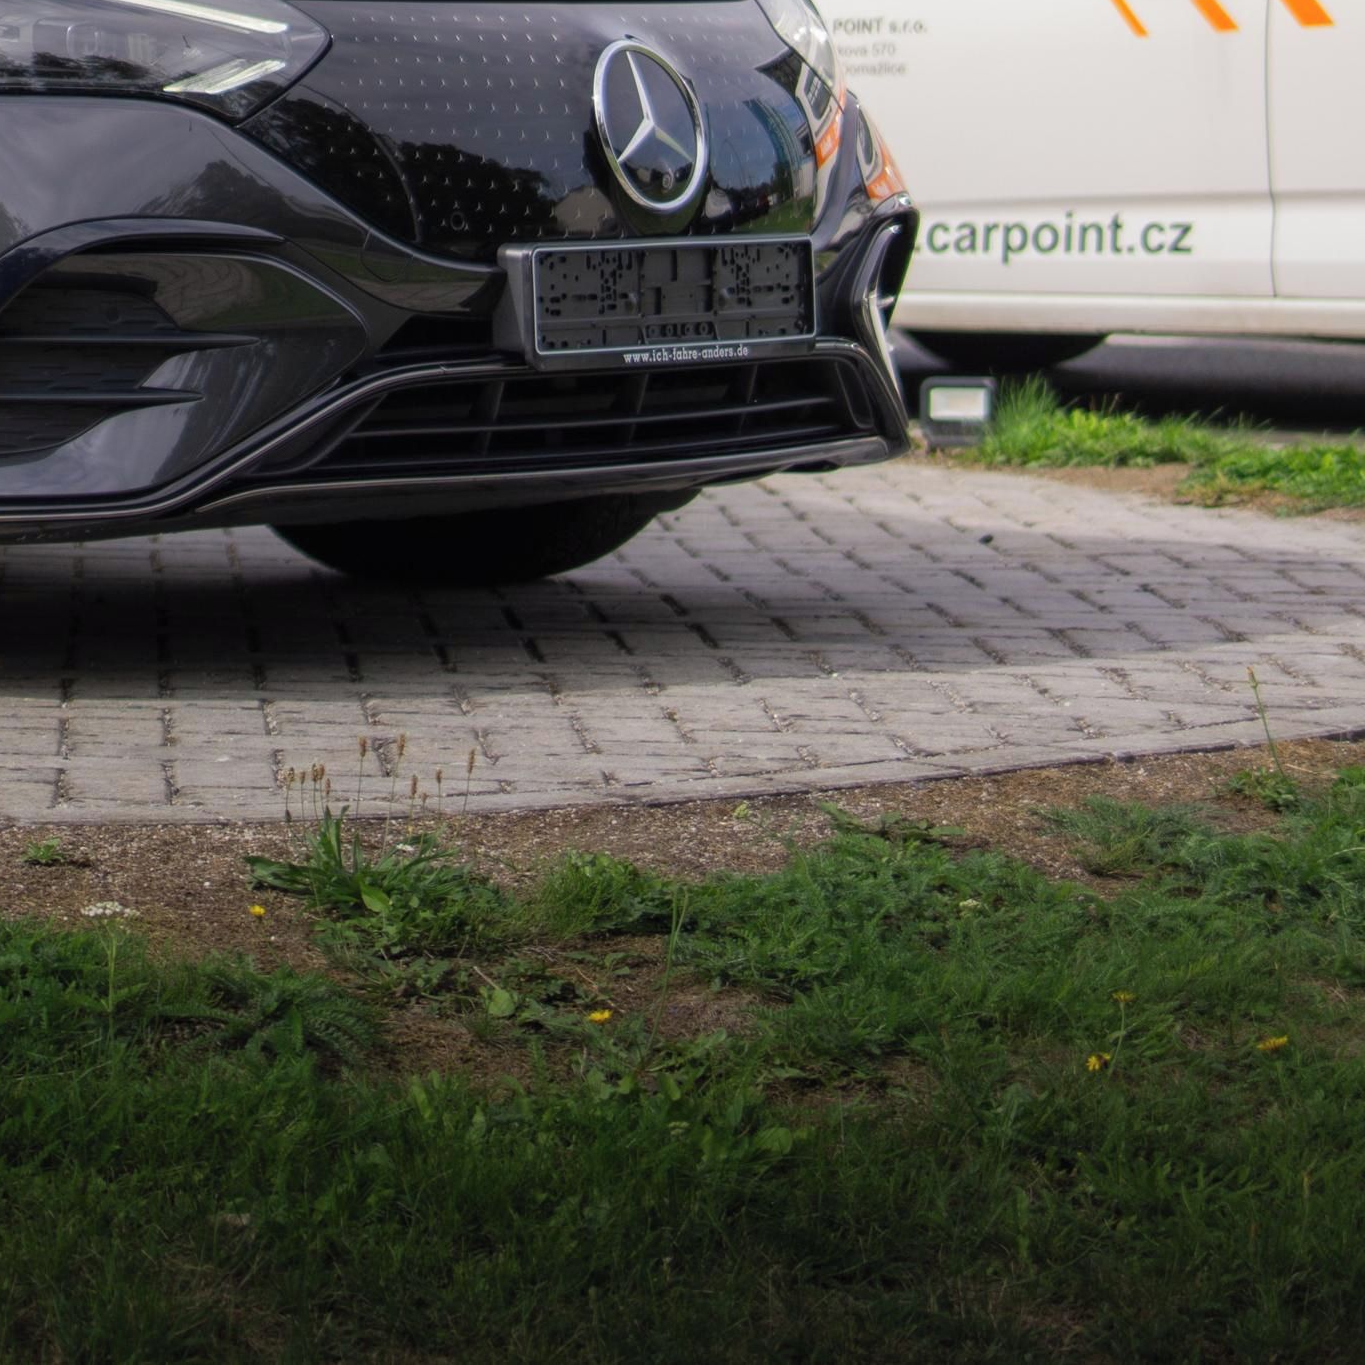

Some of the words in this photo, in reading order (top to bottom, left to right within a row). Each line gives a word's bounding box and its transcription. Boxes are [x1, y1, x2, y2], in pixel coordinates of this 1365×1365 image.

[832, 17, 884, 34] POINT
[888, 19, 928, 34] s.r.o.
[622, 344, 750, 364] www.ich-fahre-anders.de
